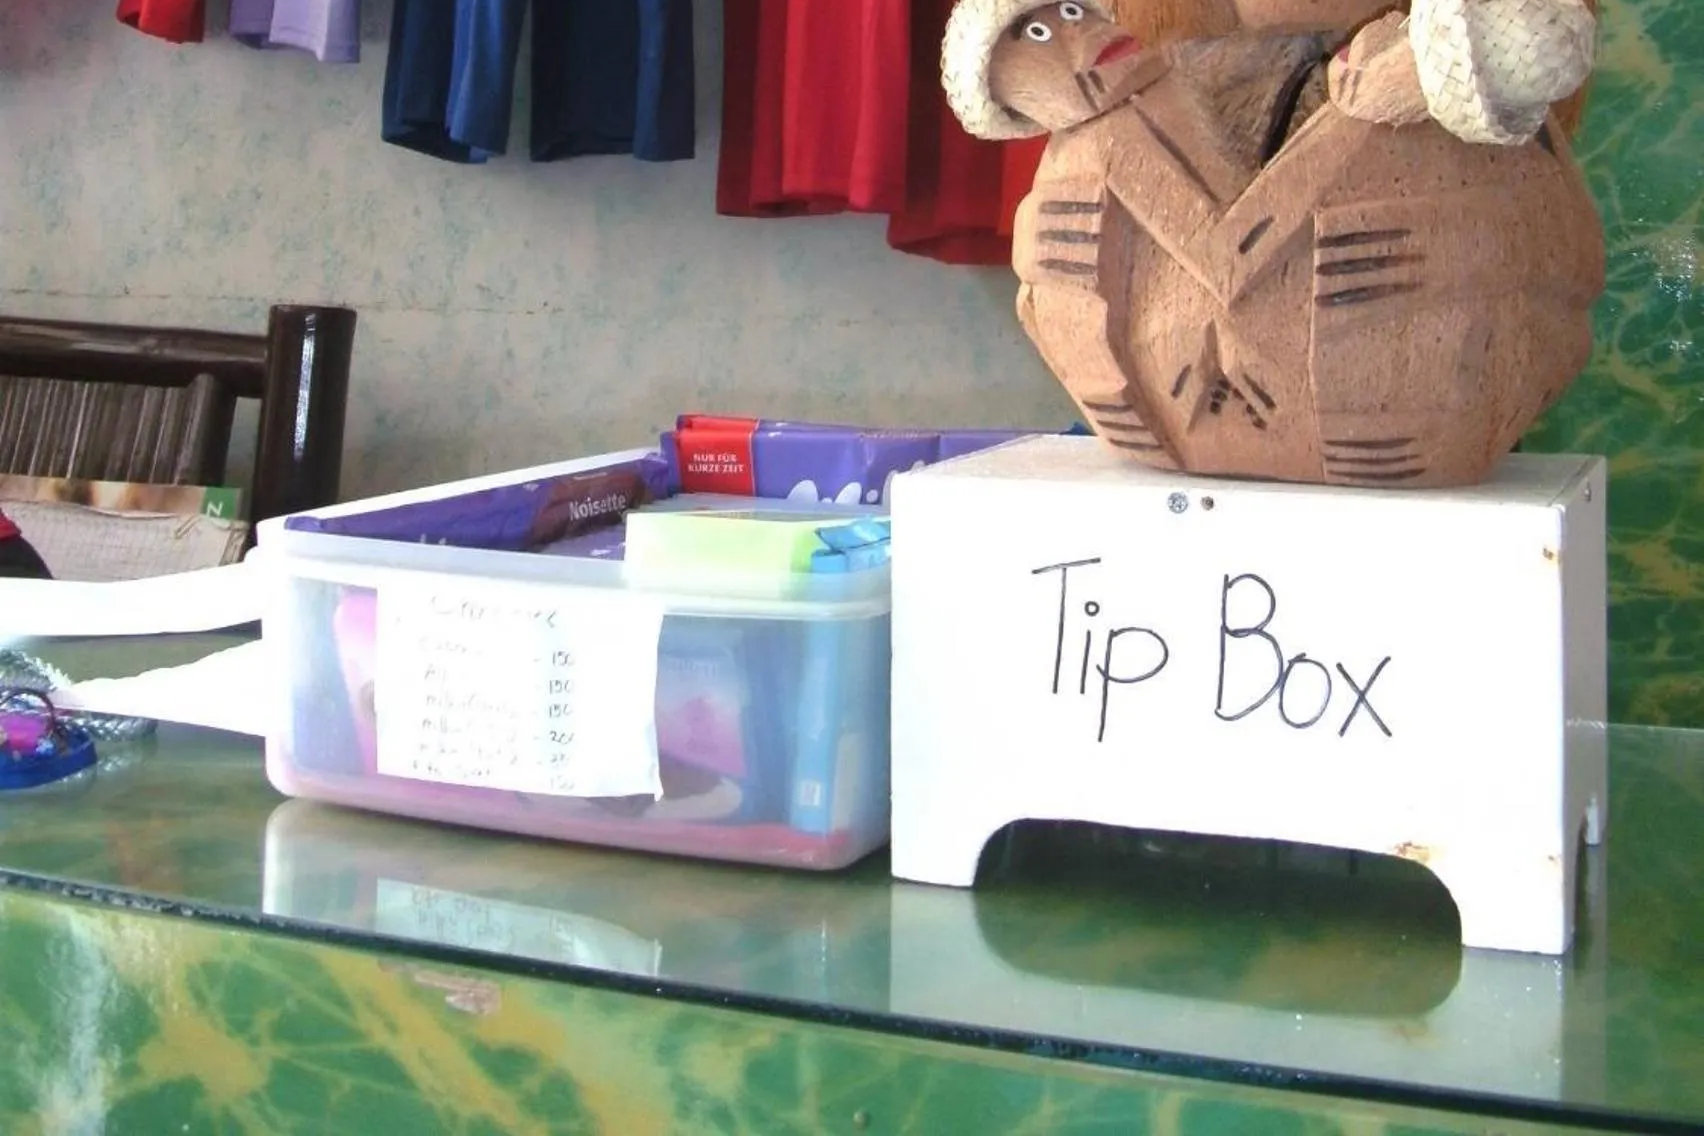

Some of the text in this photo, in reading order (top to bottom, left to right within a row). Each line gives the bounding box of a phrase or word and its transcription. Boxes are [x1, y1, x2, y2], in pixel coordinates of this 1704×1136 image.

[569, 491, 626, 521] Noisette
[1031, 557, 1393, 743] Tip Box
